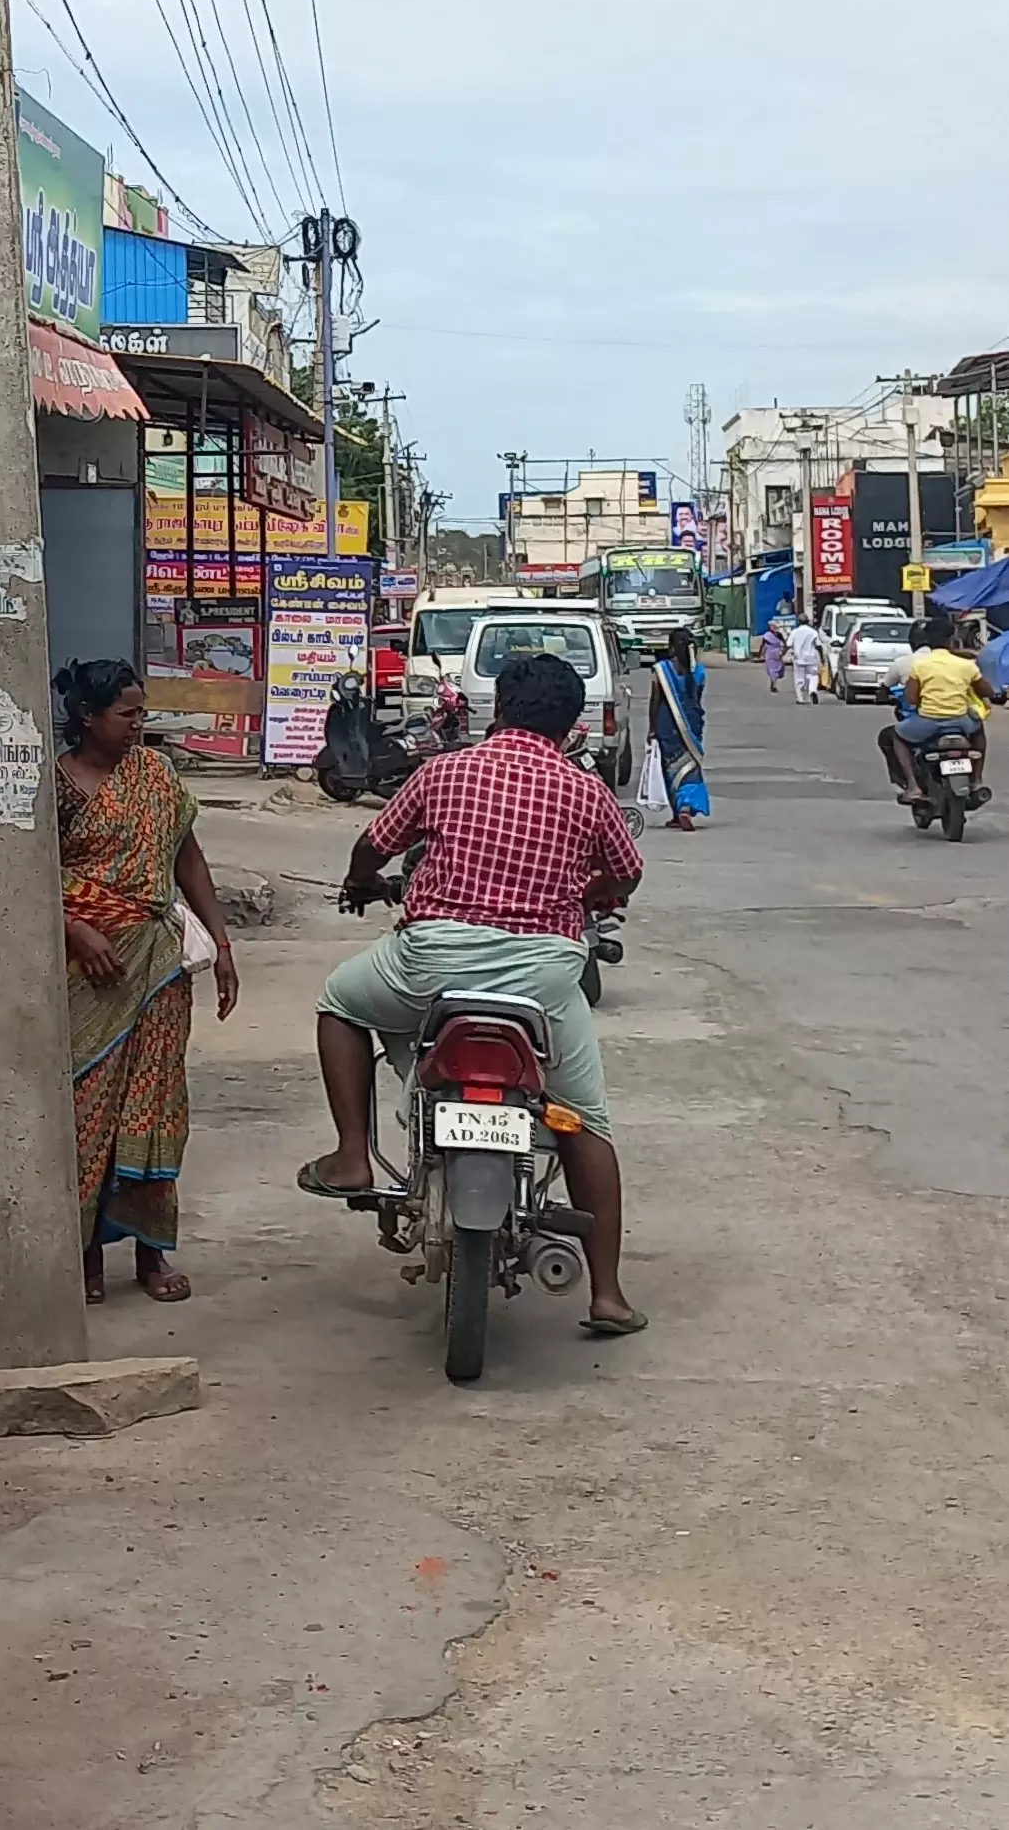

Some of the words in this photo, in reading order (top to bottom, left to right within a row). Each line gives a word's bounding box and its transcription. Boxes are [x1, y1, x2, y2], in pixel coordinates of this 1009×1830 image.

[872, 521, 912, 532] MAH
[820, 518, 845, 574] ROOMS
[274, 570, 365, 591] ஸ்ரீசிவம்
[297, 651, 336, 664] மதியம்
[292, 668, 335, 682] சாப்பா
